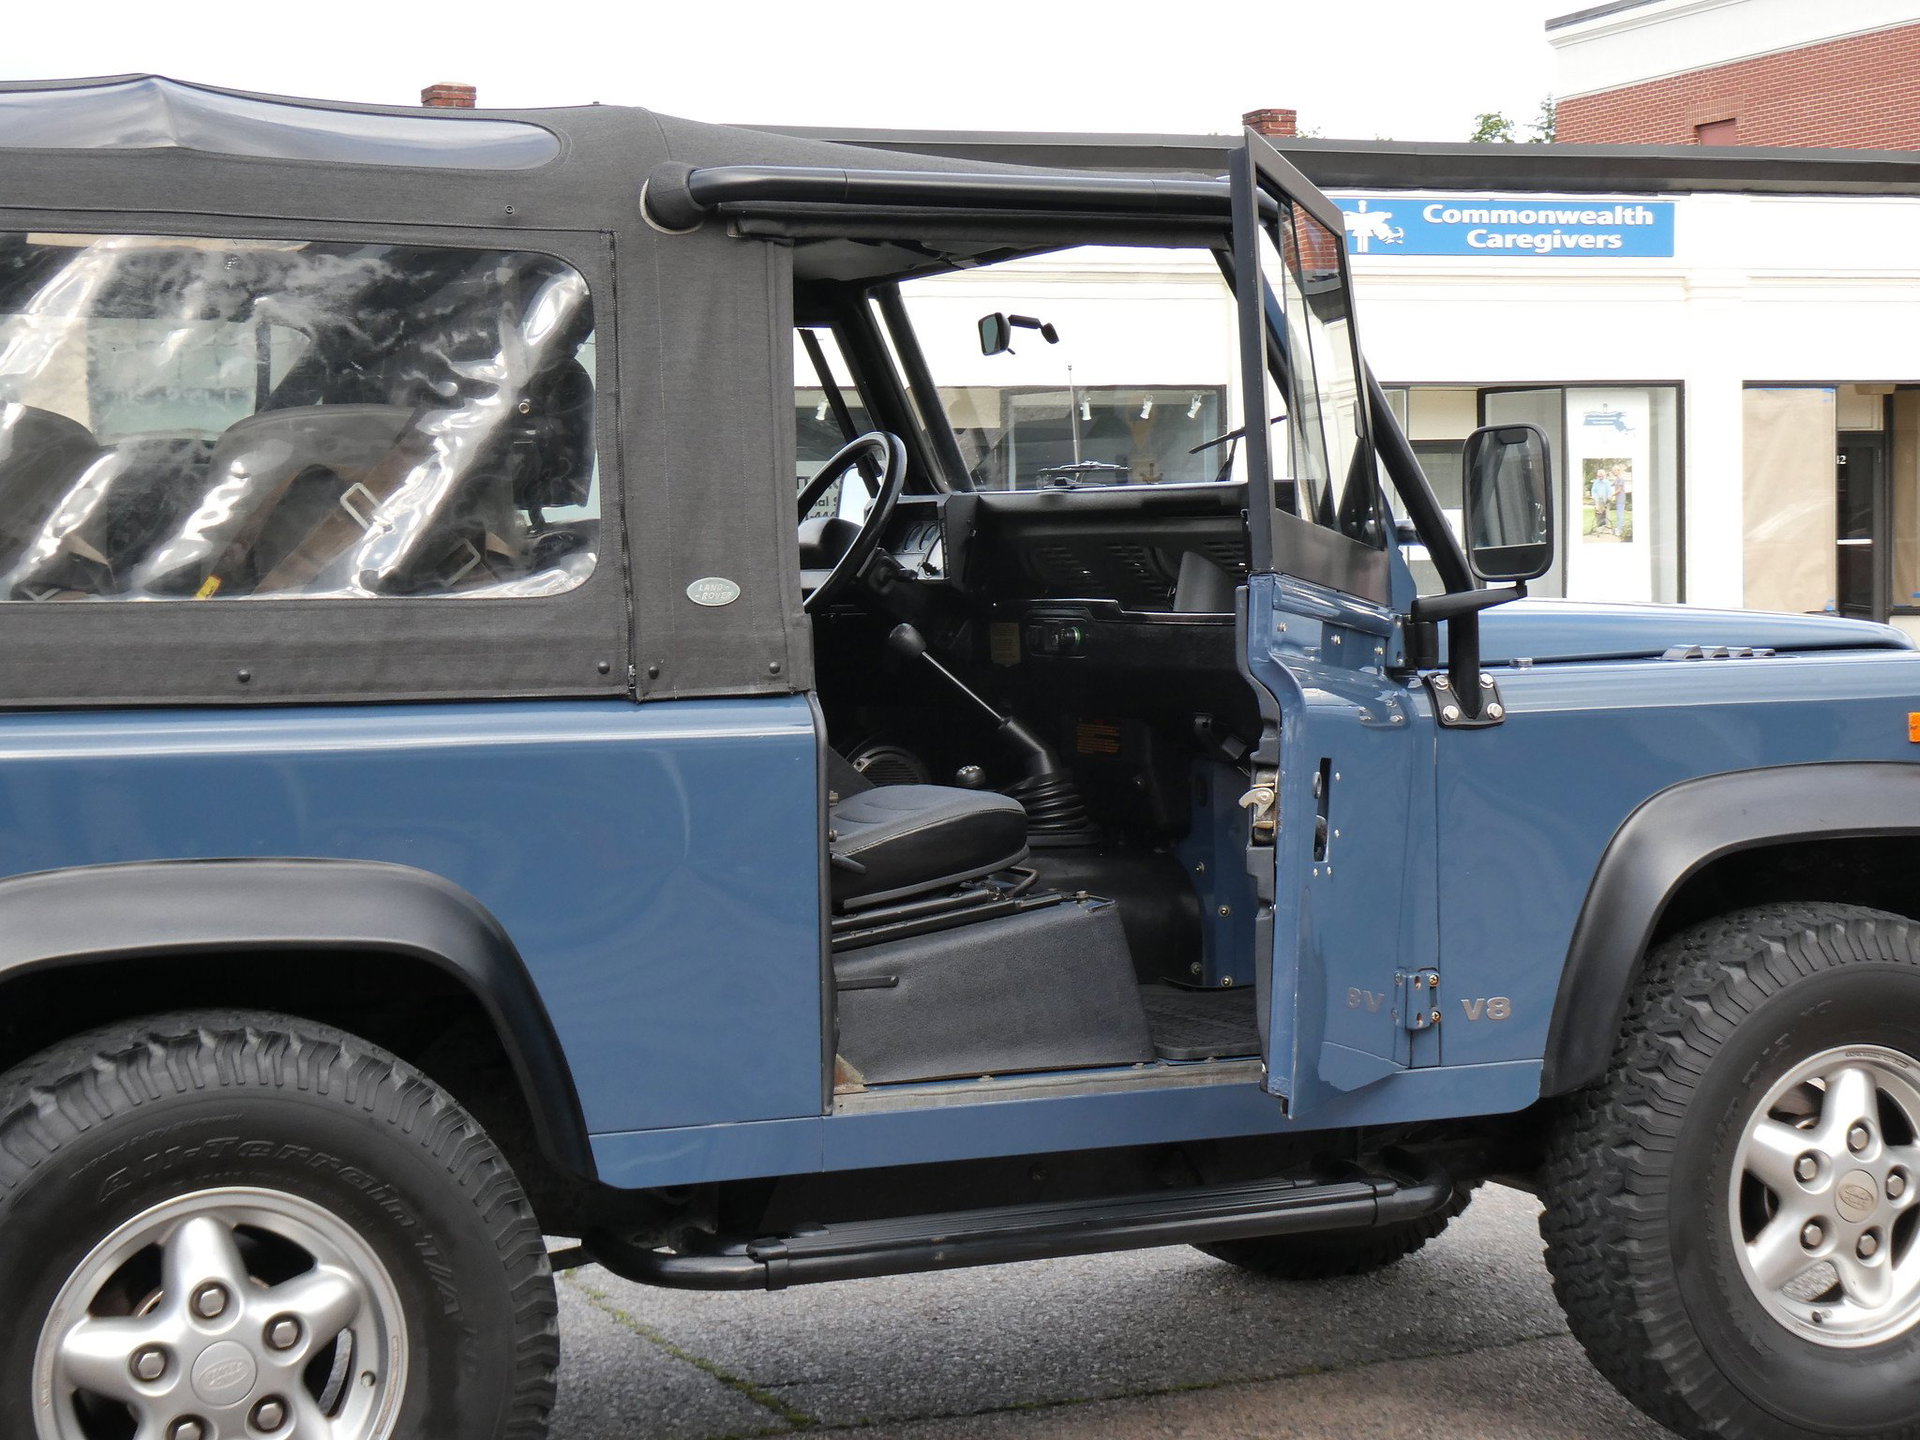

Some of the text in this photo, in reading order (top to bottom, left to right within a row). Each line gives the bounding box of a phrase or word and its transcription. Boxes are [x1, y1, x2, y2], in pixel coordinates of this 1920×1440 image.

[1423, 204, 1654, 226] Commonwealth
[1466, 229, 1623, 254] Caregivers
[1460, 996, 1512, 1022] V8
